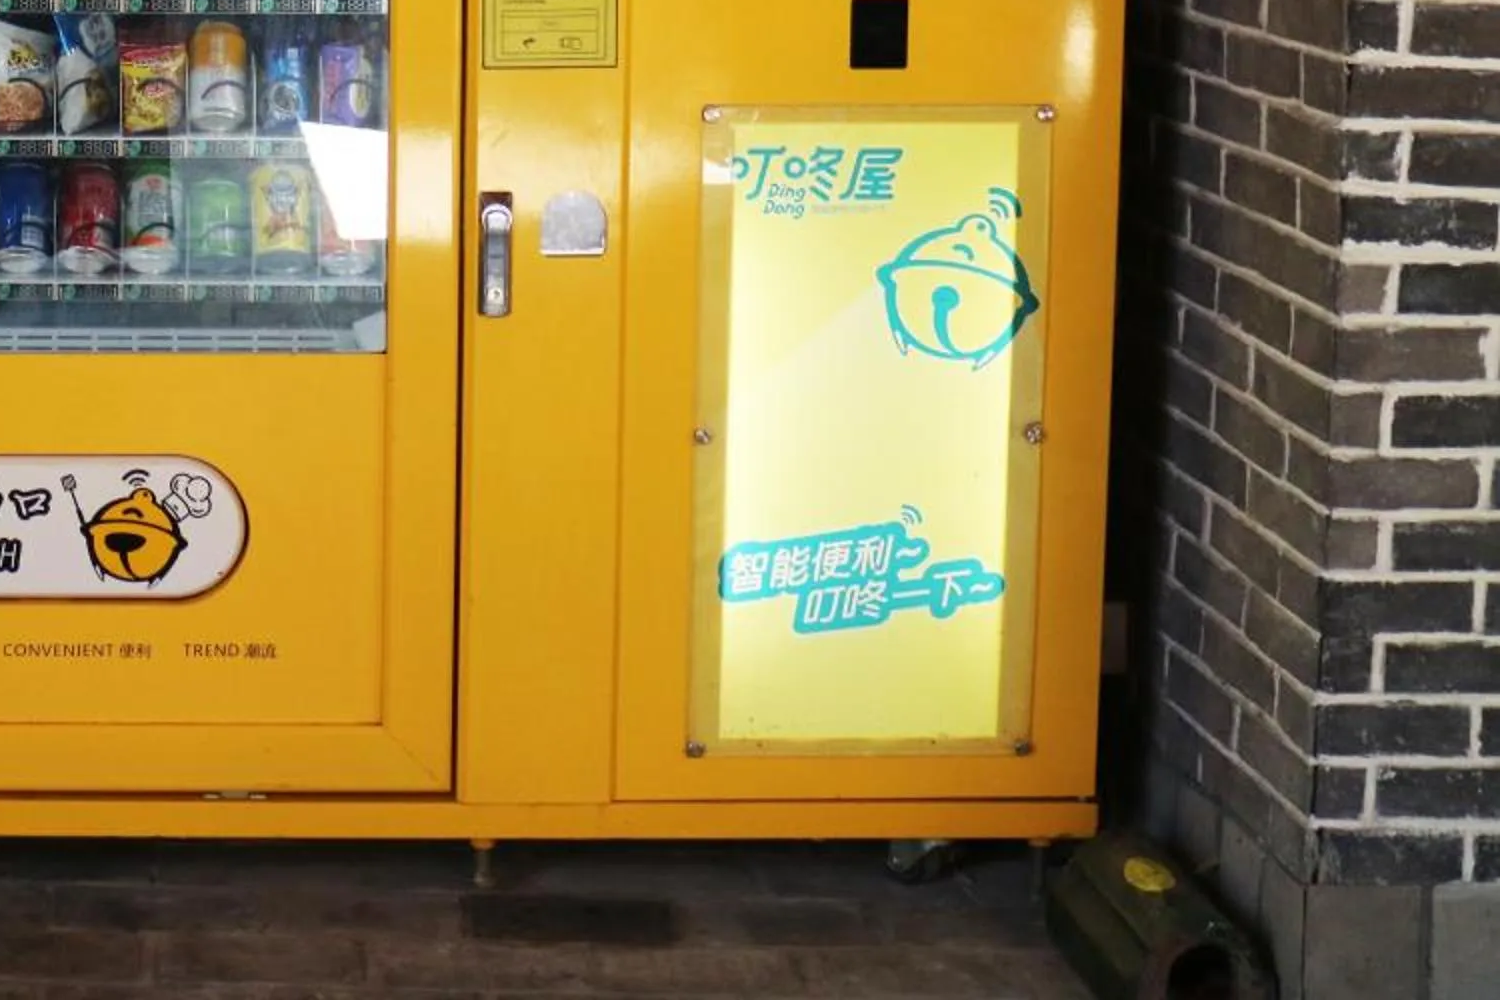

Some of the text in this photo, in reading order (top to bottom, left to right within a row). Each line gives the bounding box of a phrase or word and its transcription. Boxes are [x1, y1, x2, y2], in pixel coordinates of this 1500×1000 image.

[768, 183, 806, 203] Ding
[763, 200, 805, 220] Dong
[3, 643, 113, 657] CONVENIENT
[184, 643, 240, 657] TREND
